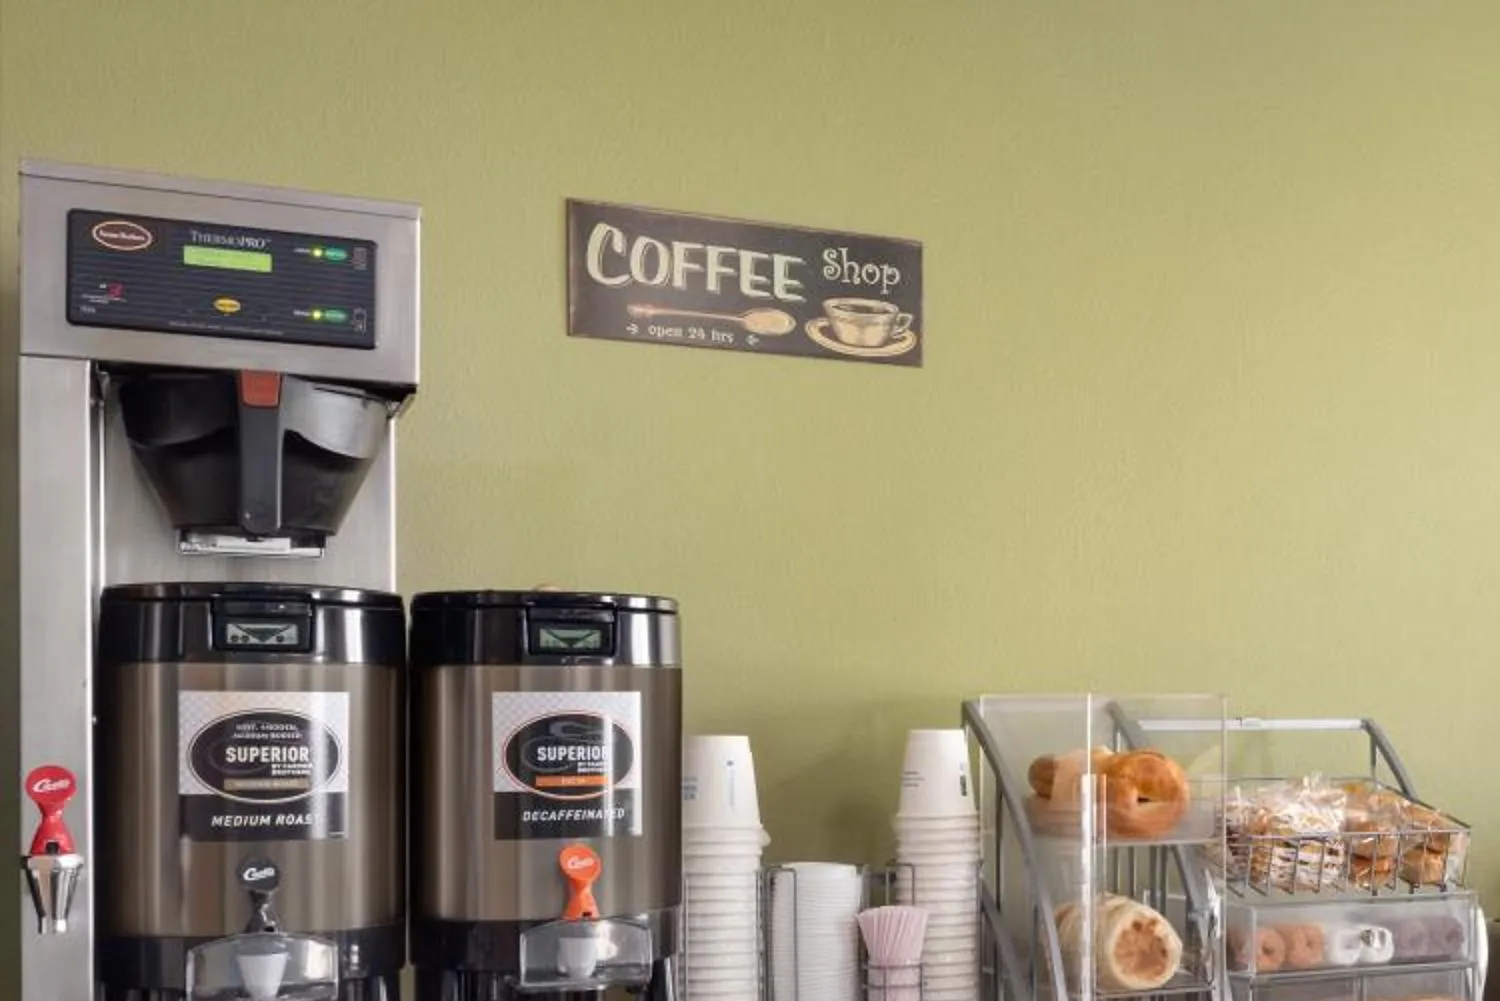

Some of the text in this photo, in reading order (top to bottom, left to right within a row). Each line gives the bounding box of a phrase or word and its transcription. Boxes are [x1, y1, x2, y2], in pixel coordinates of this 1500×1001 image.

[586, 222, 900, 302] COFFEE Shop
[647, 324, 735, 344] open 24 hrs
[225, 746, 310, 763] SUPERIOR
[537, 745, 610, 761] SUPERIOR
[211, 815, 272, 827] MEDIUM
